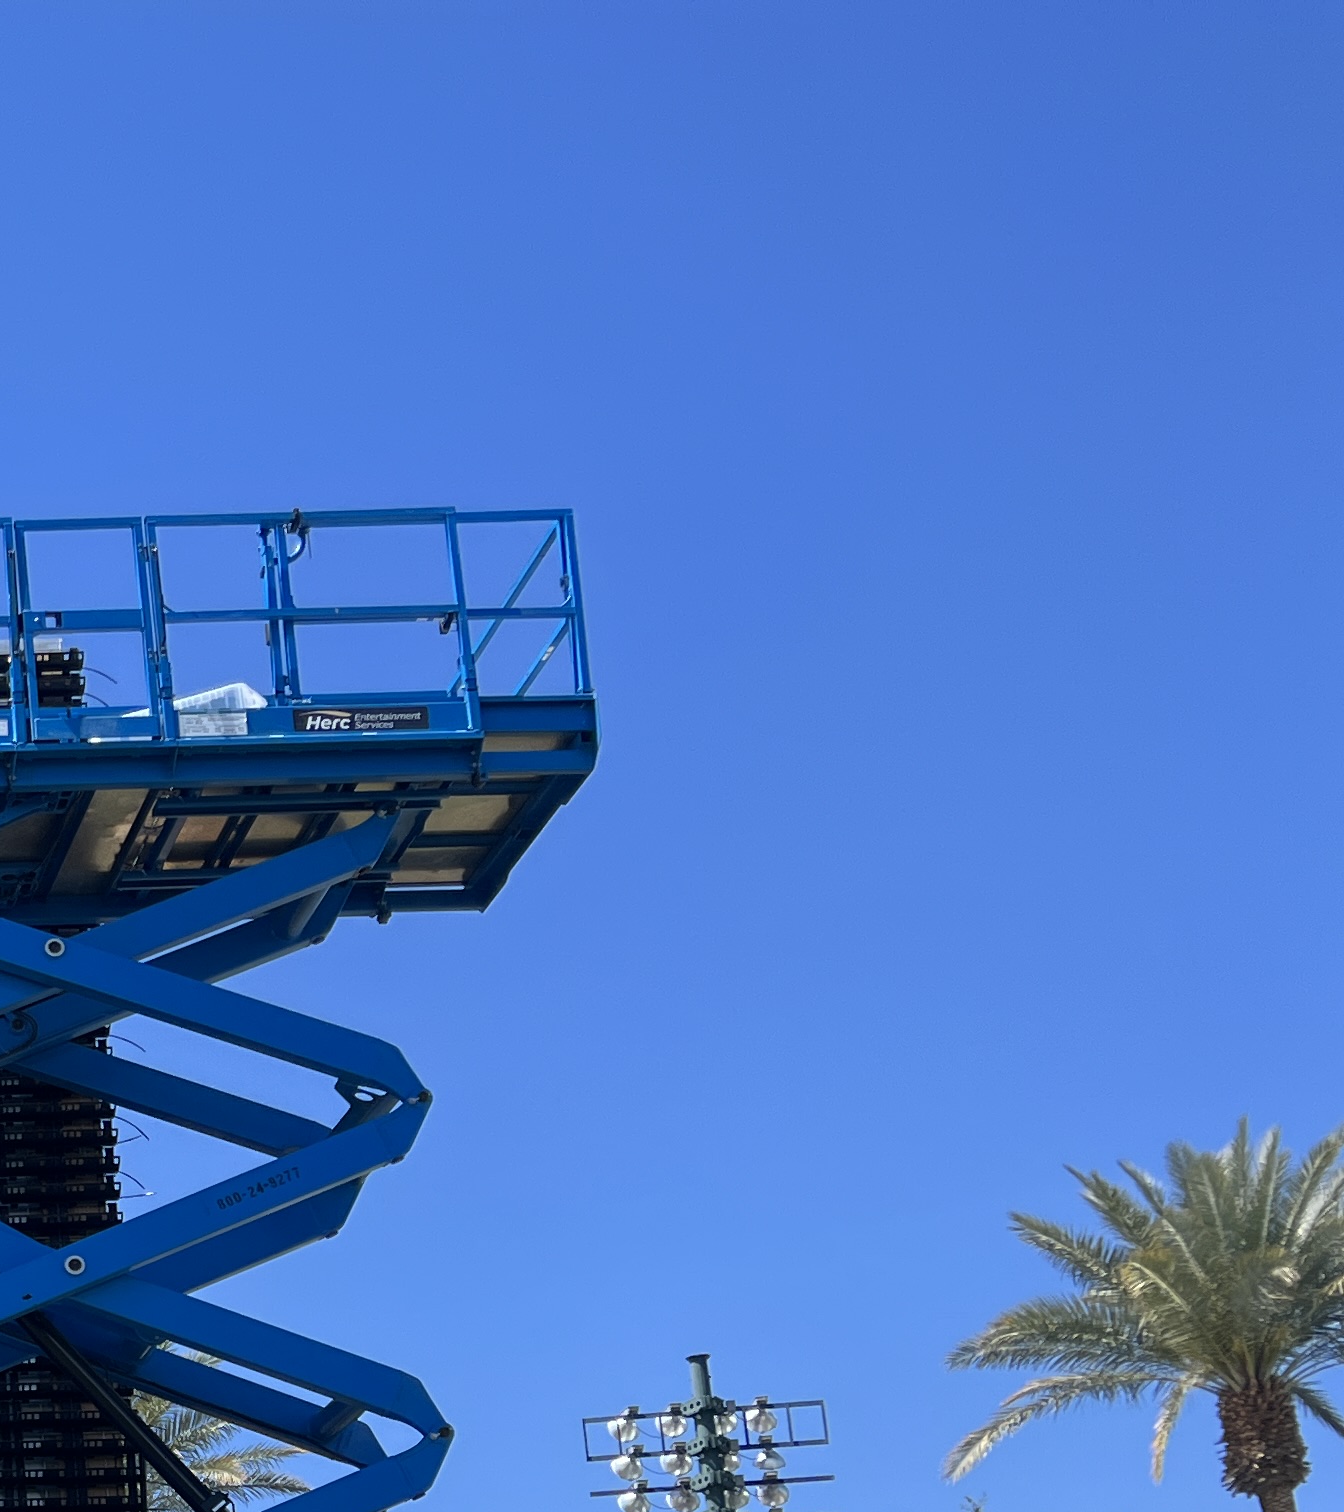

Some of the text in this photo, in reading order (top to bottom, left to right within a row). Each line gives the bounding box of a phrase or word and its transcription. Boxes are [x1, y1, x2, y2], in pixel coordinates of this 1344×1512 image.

[354, 712, 421, 722] Entertainment
[306, 716, 351, 730] Herc
[354, 720, 394, 730] Services
